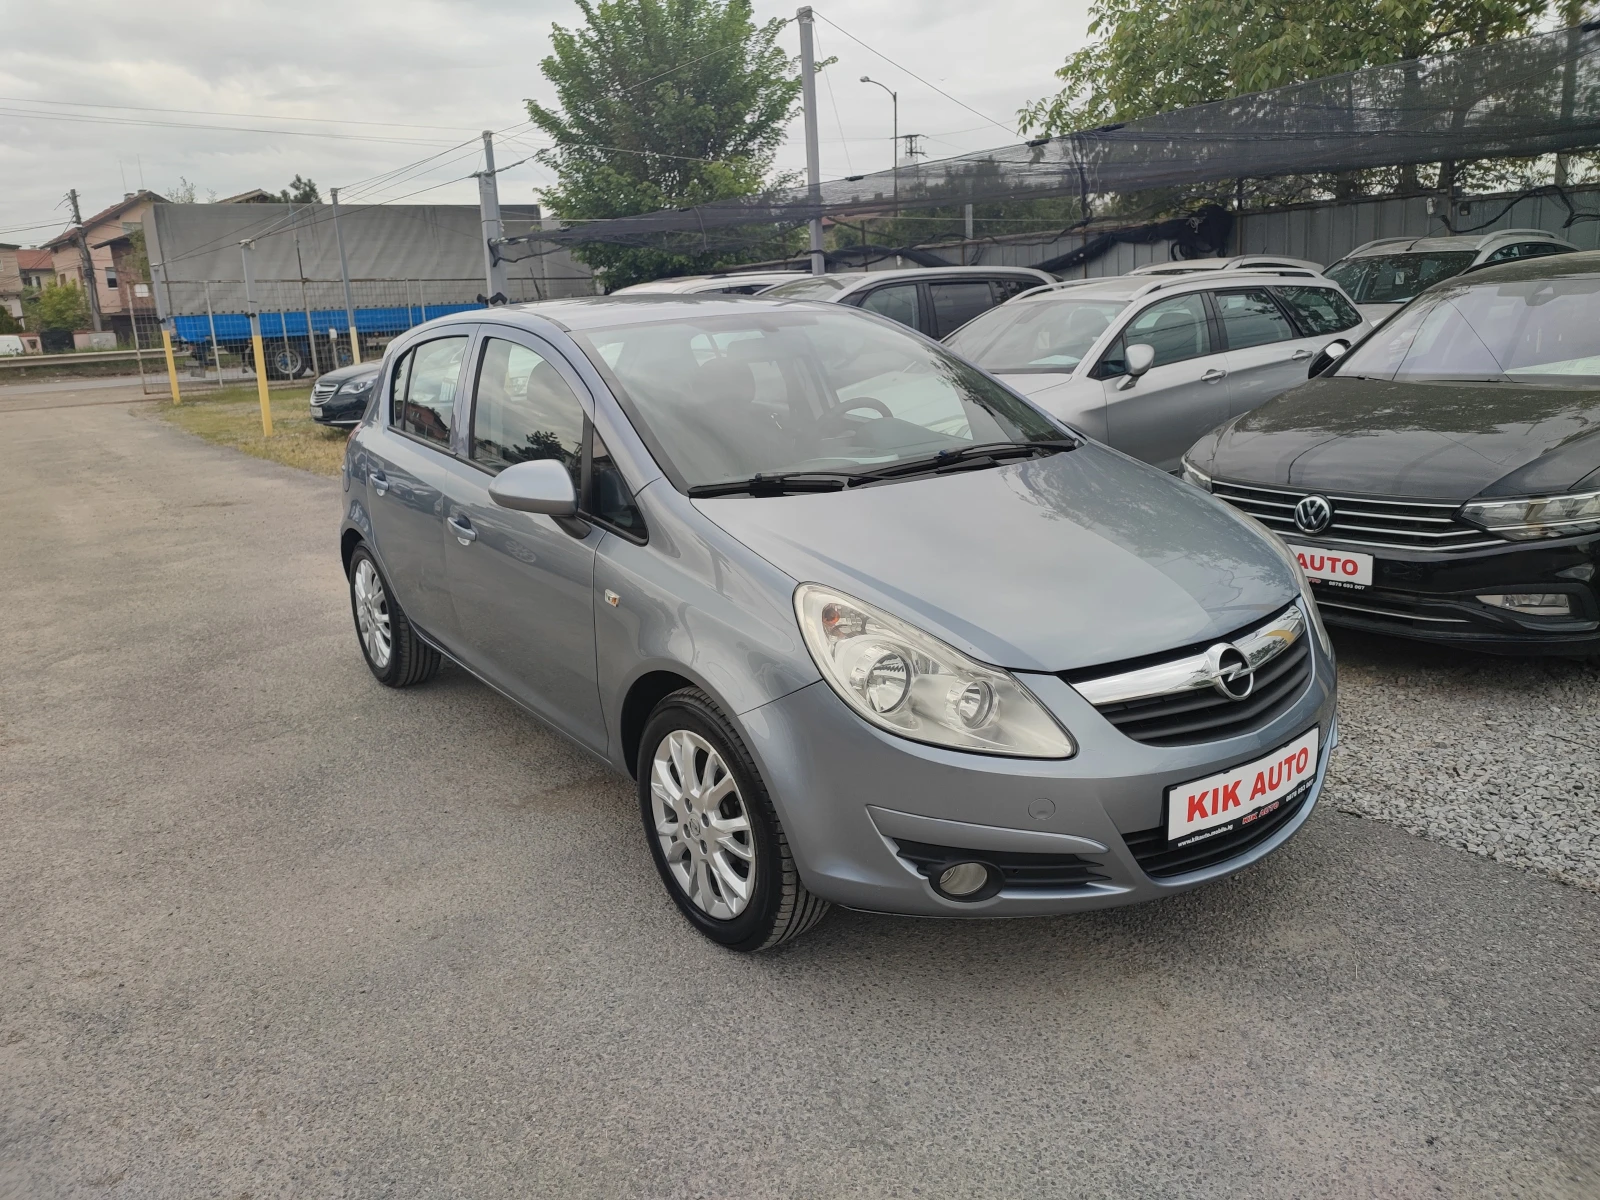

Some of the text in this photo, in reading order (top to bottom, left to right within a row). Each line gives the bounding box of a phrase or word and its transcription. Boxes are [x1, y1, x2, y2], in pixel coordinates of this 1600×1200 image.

[1296, 552, 1358, 576] AUTO
[1186, 746, 1309, 823] KIK AUTO
[1242, 801, 1280, 825] KIK AUTO
